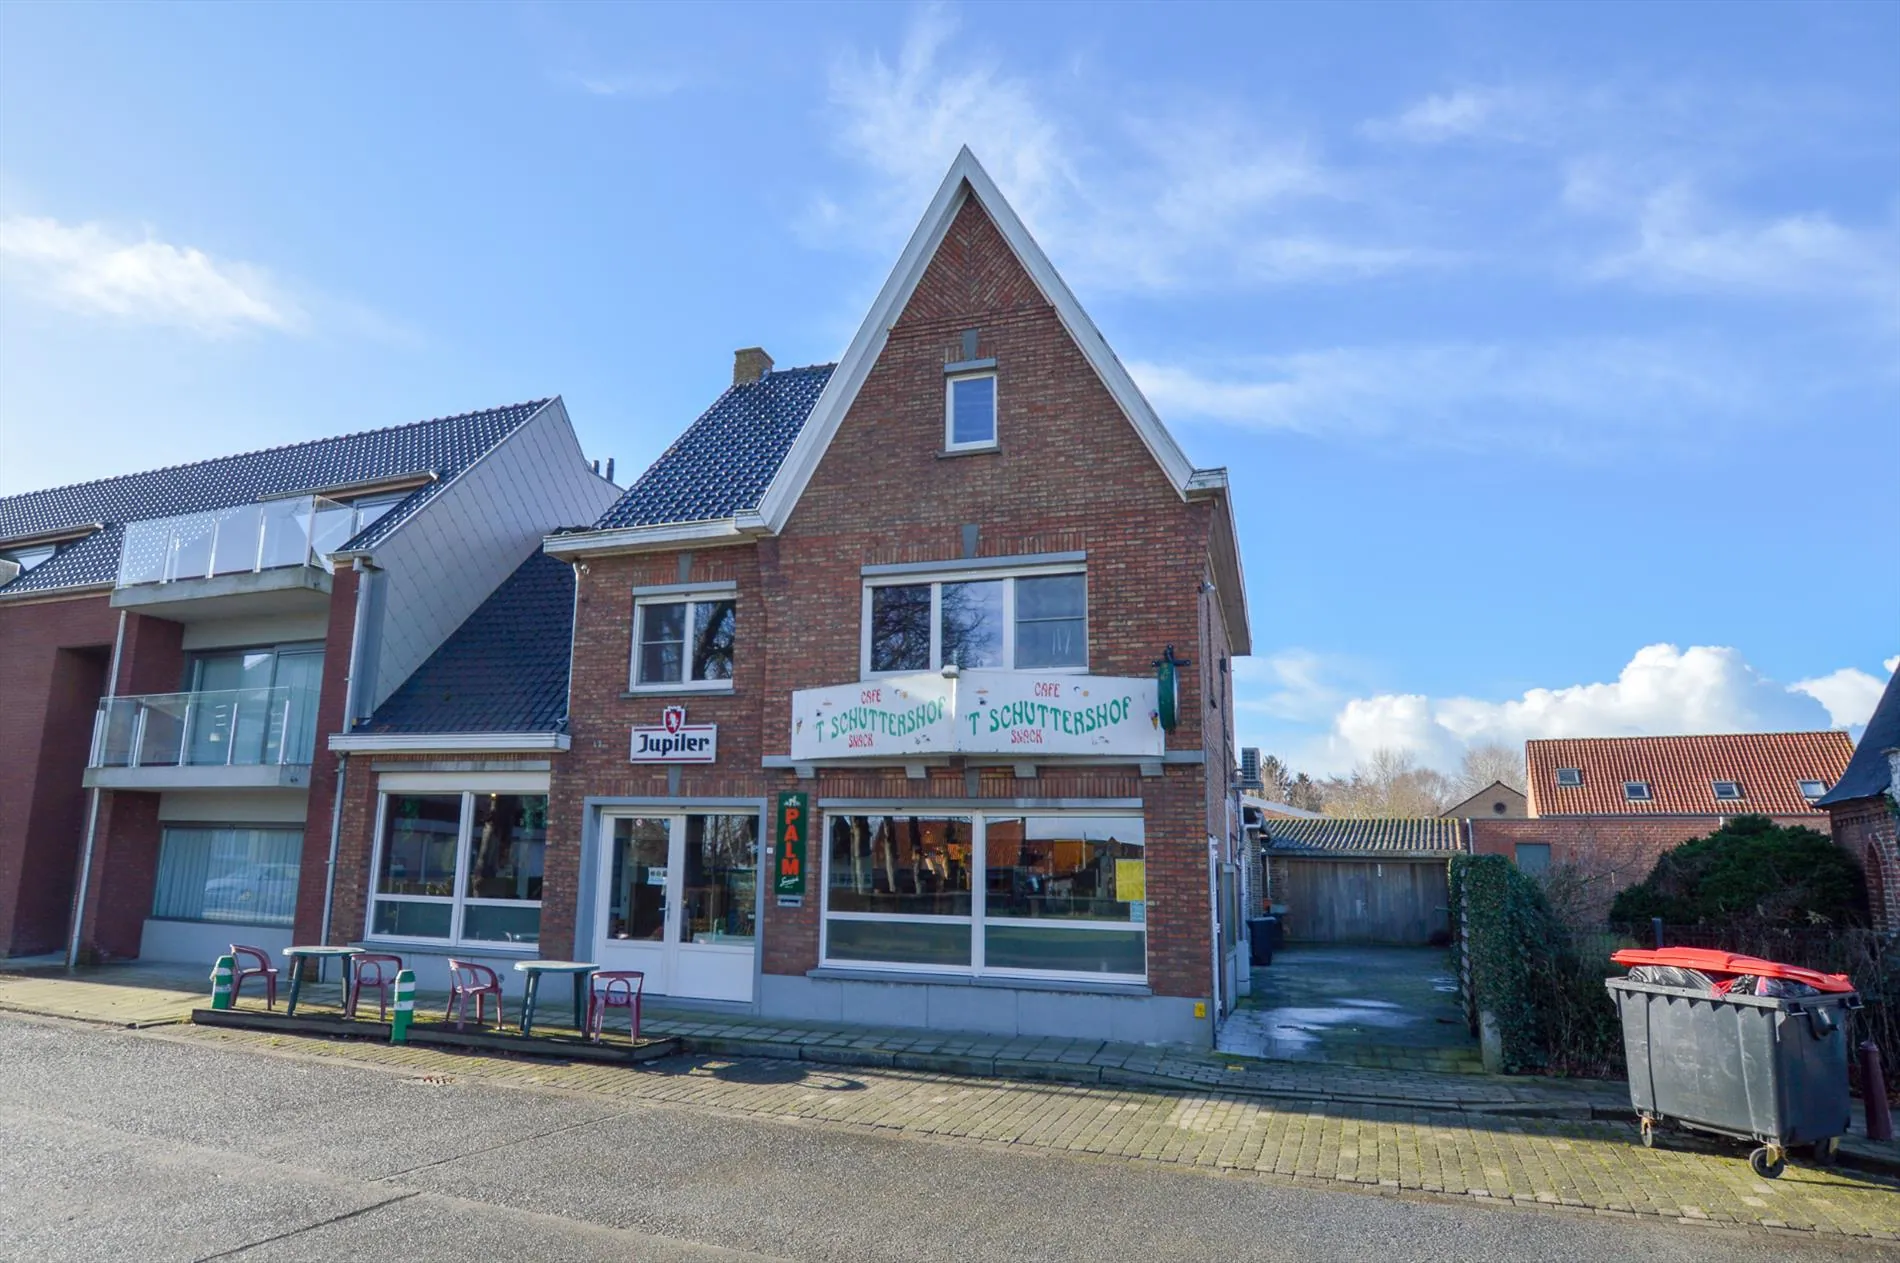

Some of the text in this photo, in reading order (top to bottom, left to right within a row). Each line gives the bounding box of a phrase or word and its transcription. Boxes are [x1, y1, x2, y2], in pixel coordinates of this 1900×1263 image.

[860, 689, 882, 705] CAFE
[1034, 682, 1061, 698] CAFE
[831, 696, 946, 740] SCHUTTERSHOF
[989, 696, 1133, 736] SCHUTTERSHOF
[637, 733, 710, 757] Jupiler
[848, 734, 874, 749] SNACK
[1010, 729, 1044, 745] SNACK
[781, 808, 800, 876] PALM
